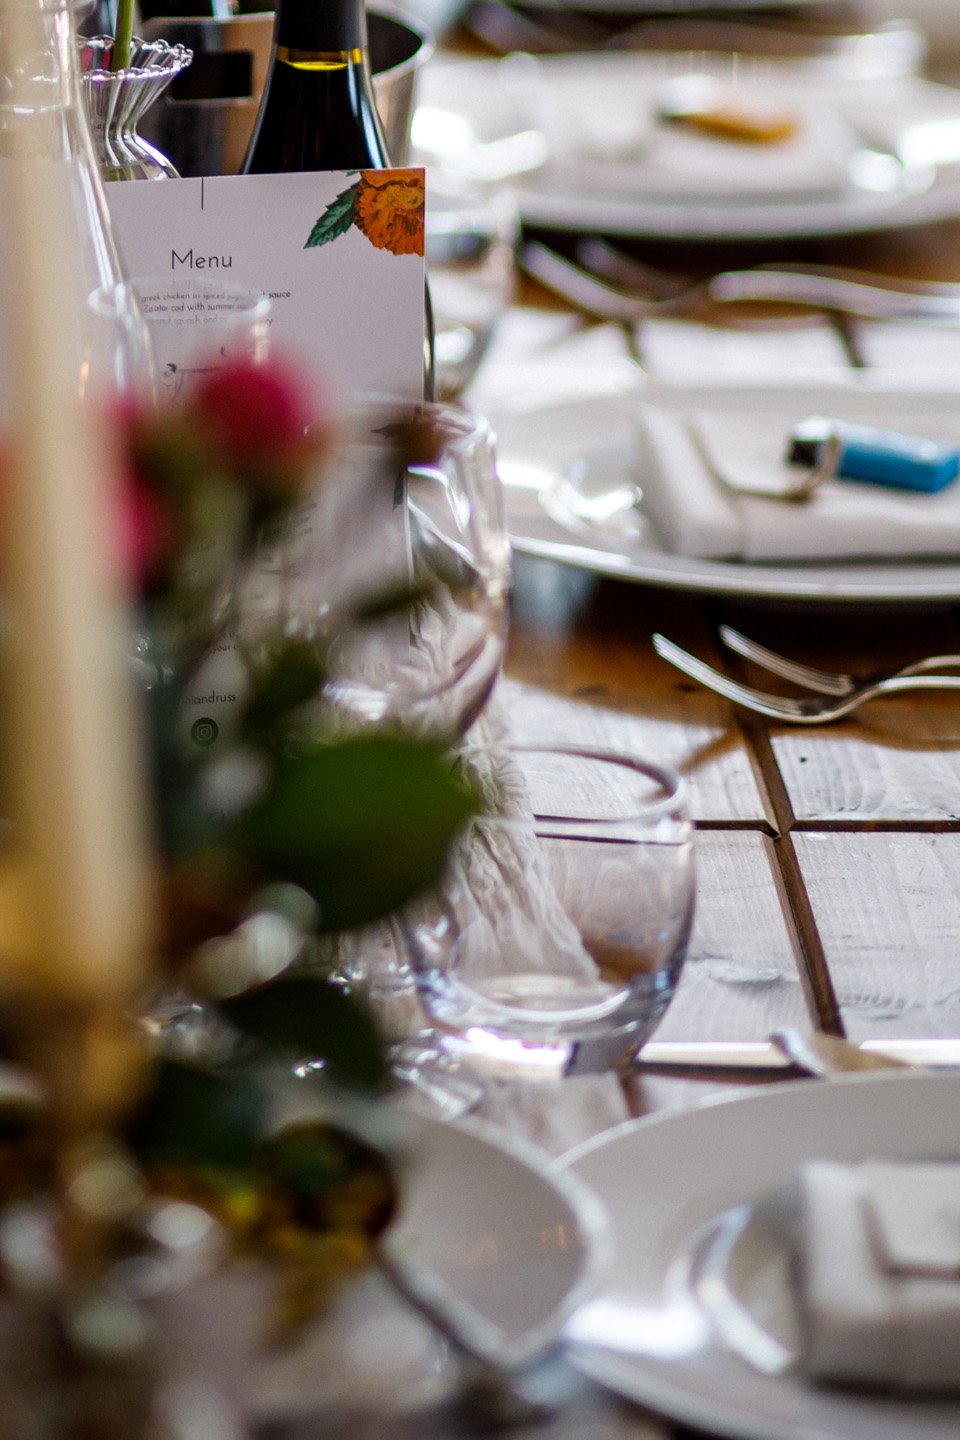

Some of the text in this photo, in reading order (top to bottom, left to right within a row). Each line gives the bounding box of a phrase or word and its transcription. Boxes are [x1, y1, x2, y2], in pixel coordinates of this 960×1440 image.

[170, 249, 234, 271] Menu
[268, 290, 291, 299] sauce
[187, 301, 205, 311] with
[207, 303, 235, 311] summer
